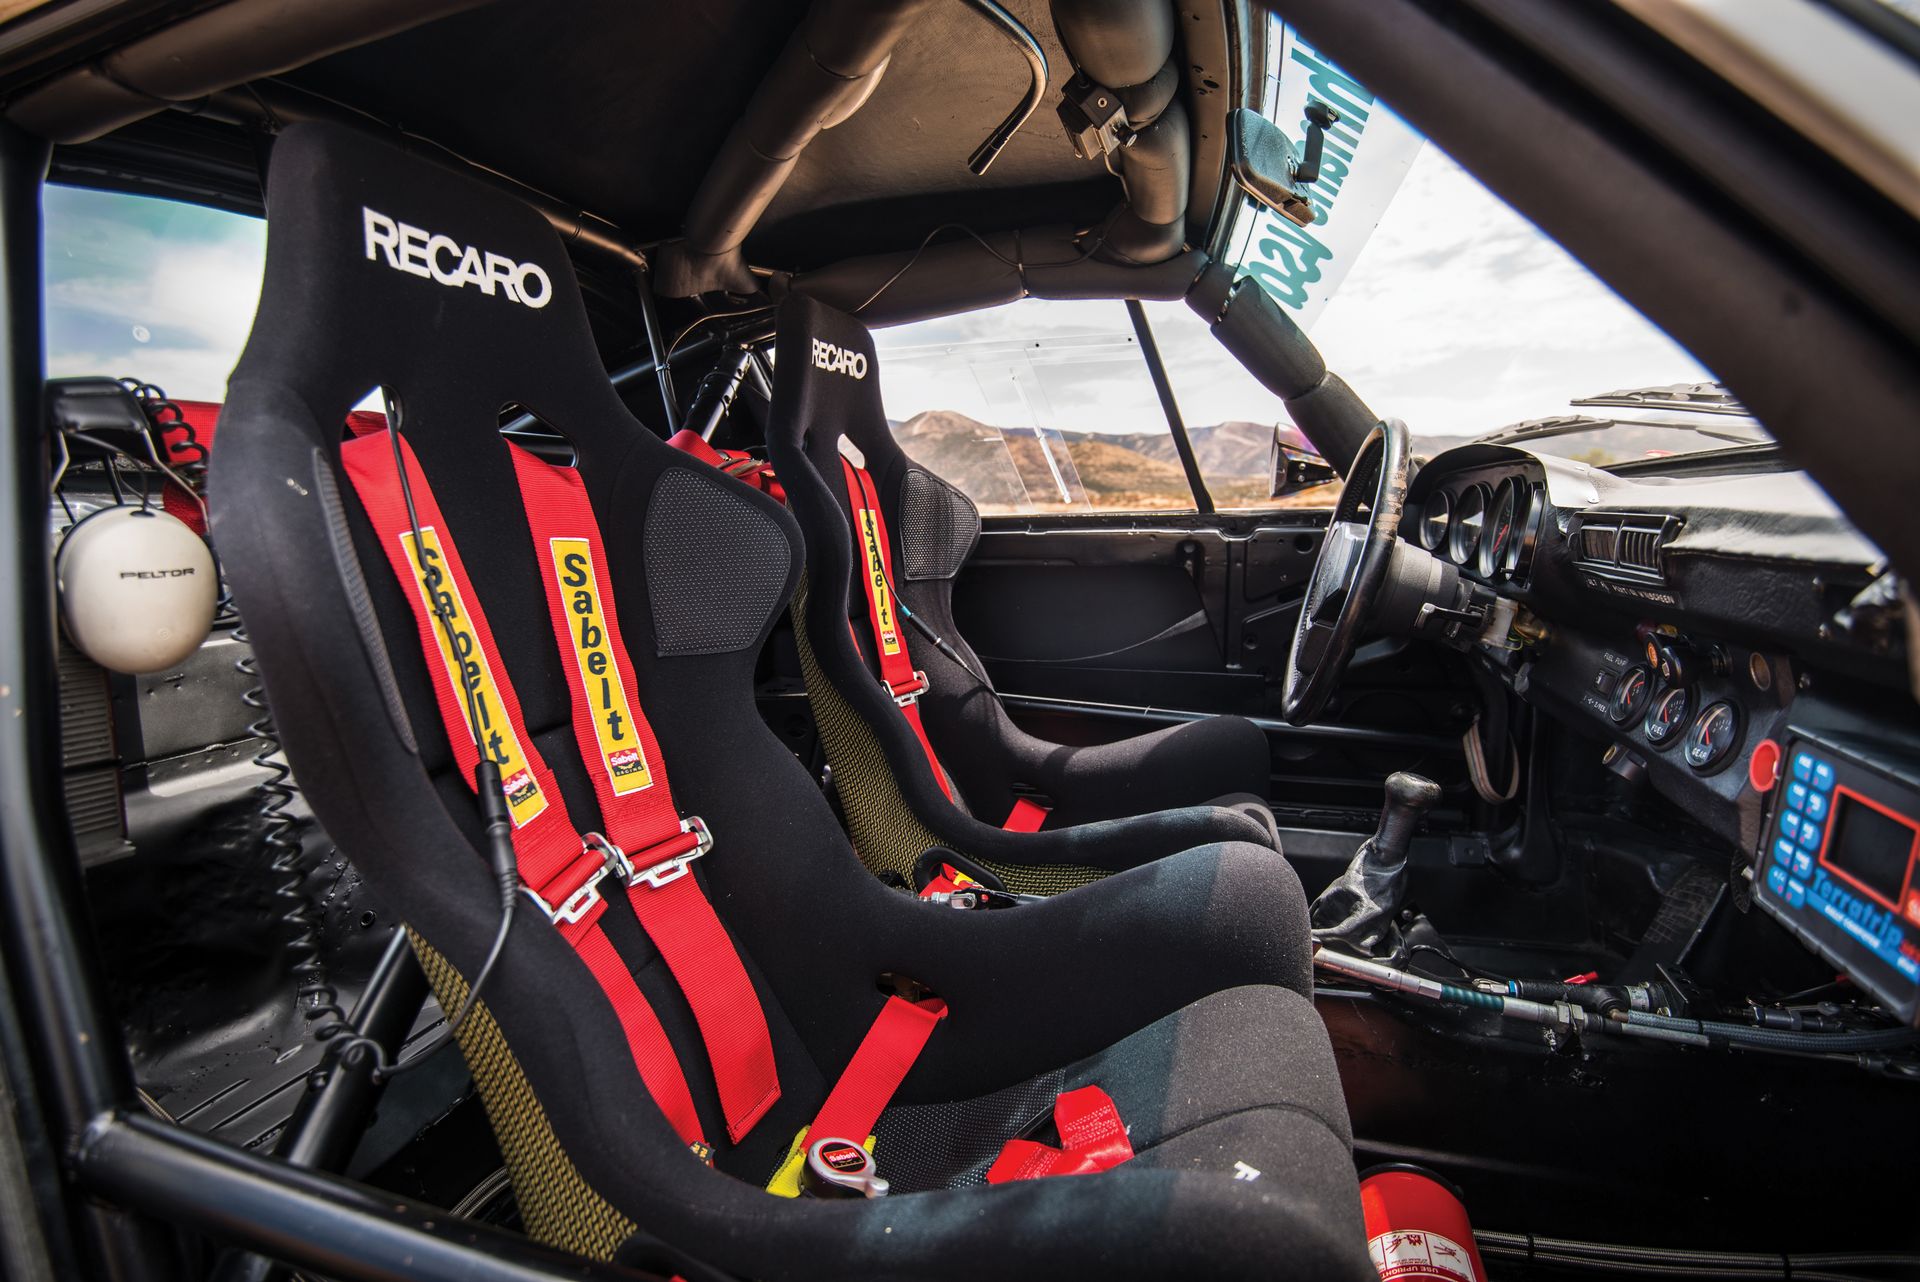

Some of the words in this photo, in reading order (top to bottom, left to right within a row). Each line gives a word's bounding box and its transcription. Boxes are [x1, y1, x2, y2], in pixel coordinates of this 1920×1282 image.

[362, 206, 552, 309] RECARO
[811, 338, 868, 380] RECARO
[120, 568, 195, 579] PELTOR
[563, 553, 624, 741] Sabelt
[1651, 723, 1664, 736] FUEL
[610, 752, 640, 767] Sabelt
[1812, 867, 1905, 950] Terratrip
[828, 1151, 858, 1163] Sabelt
[1381, 1264, 1419, 1279] UPRIGHT
[1419, 1265, 1439, 1274] USE
